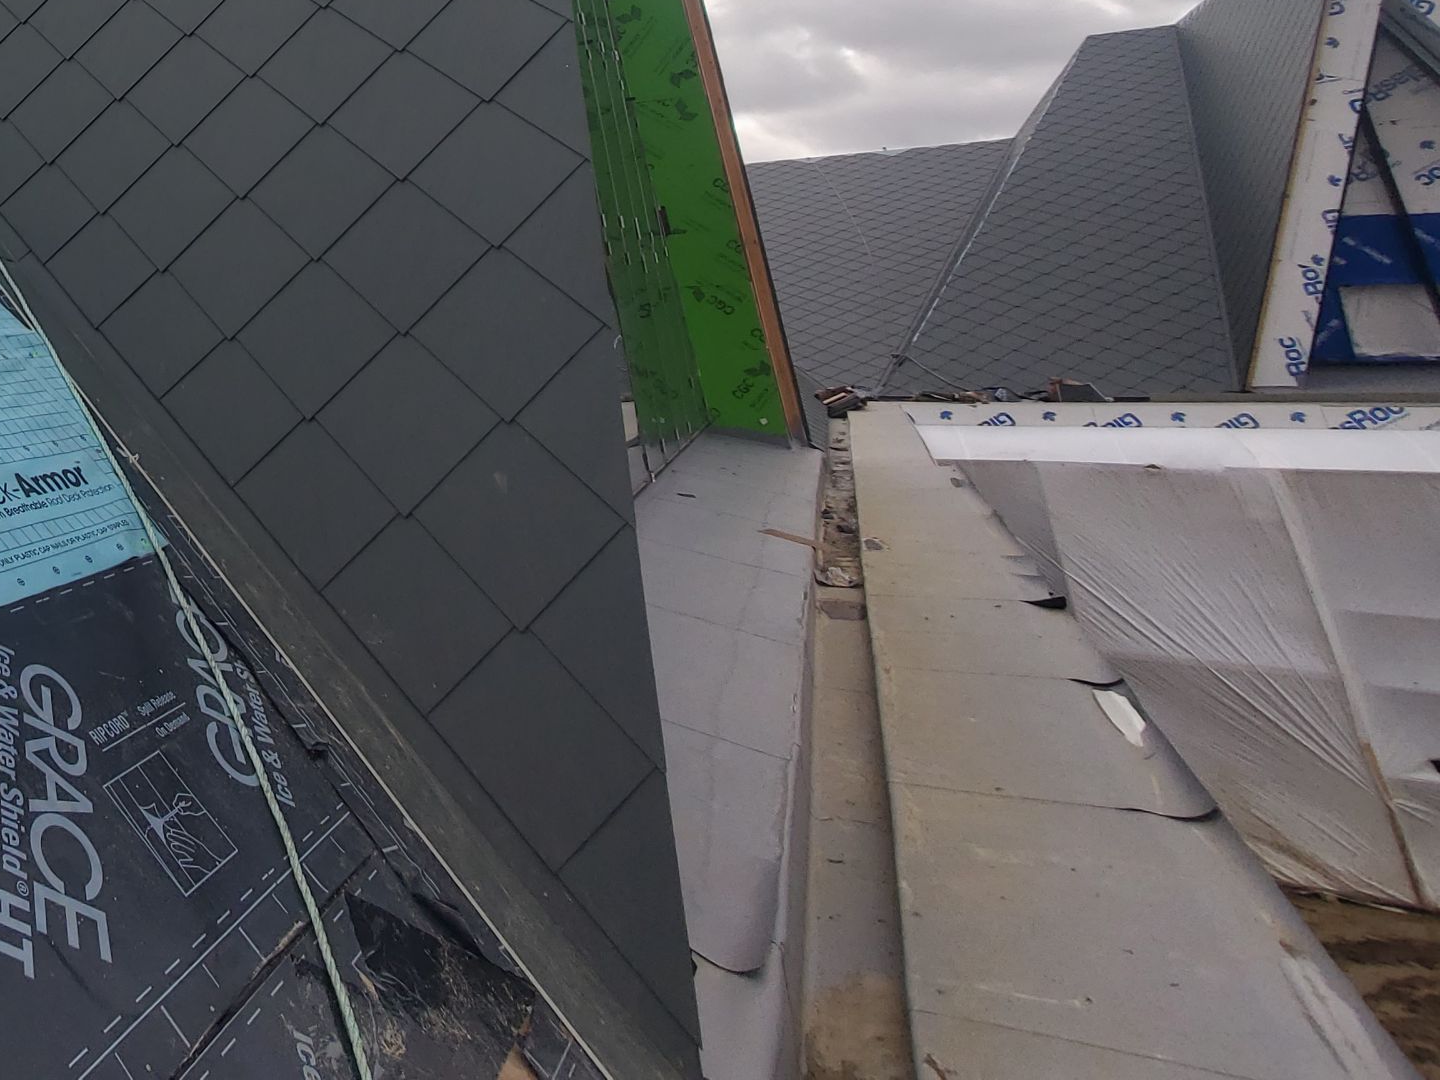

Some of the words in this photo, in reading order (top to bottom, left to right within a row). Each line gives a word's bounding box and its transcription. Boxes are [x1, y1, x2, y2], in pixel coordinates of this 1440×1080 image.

[6, 500, 48, 517] Breathable
[14, 548, 39, 564] PLASTIC
[39, 543, 51, 556] CAP
[248, 686, 275, 745] Water
[155, 726, 168, 738] On
[261, 749, 283, 770] &
[275, 772, 296, 808] Ice
[18, 663, 114, 965] GRACE
